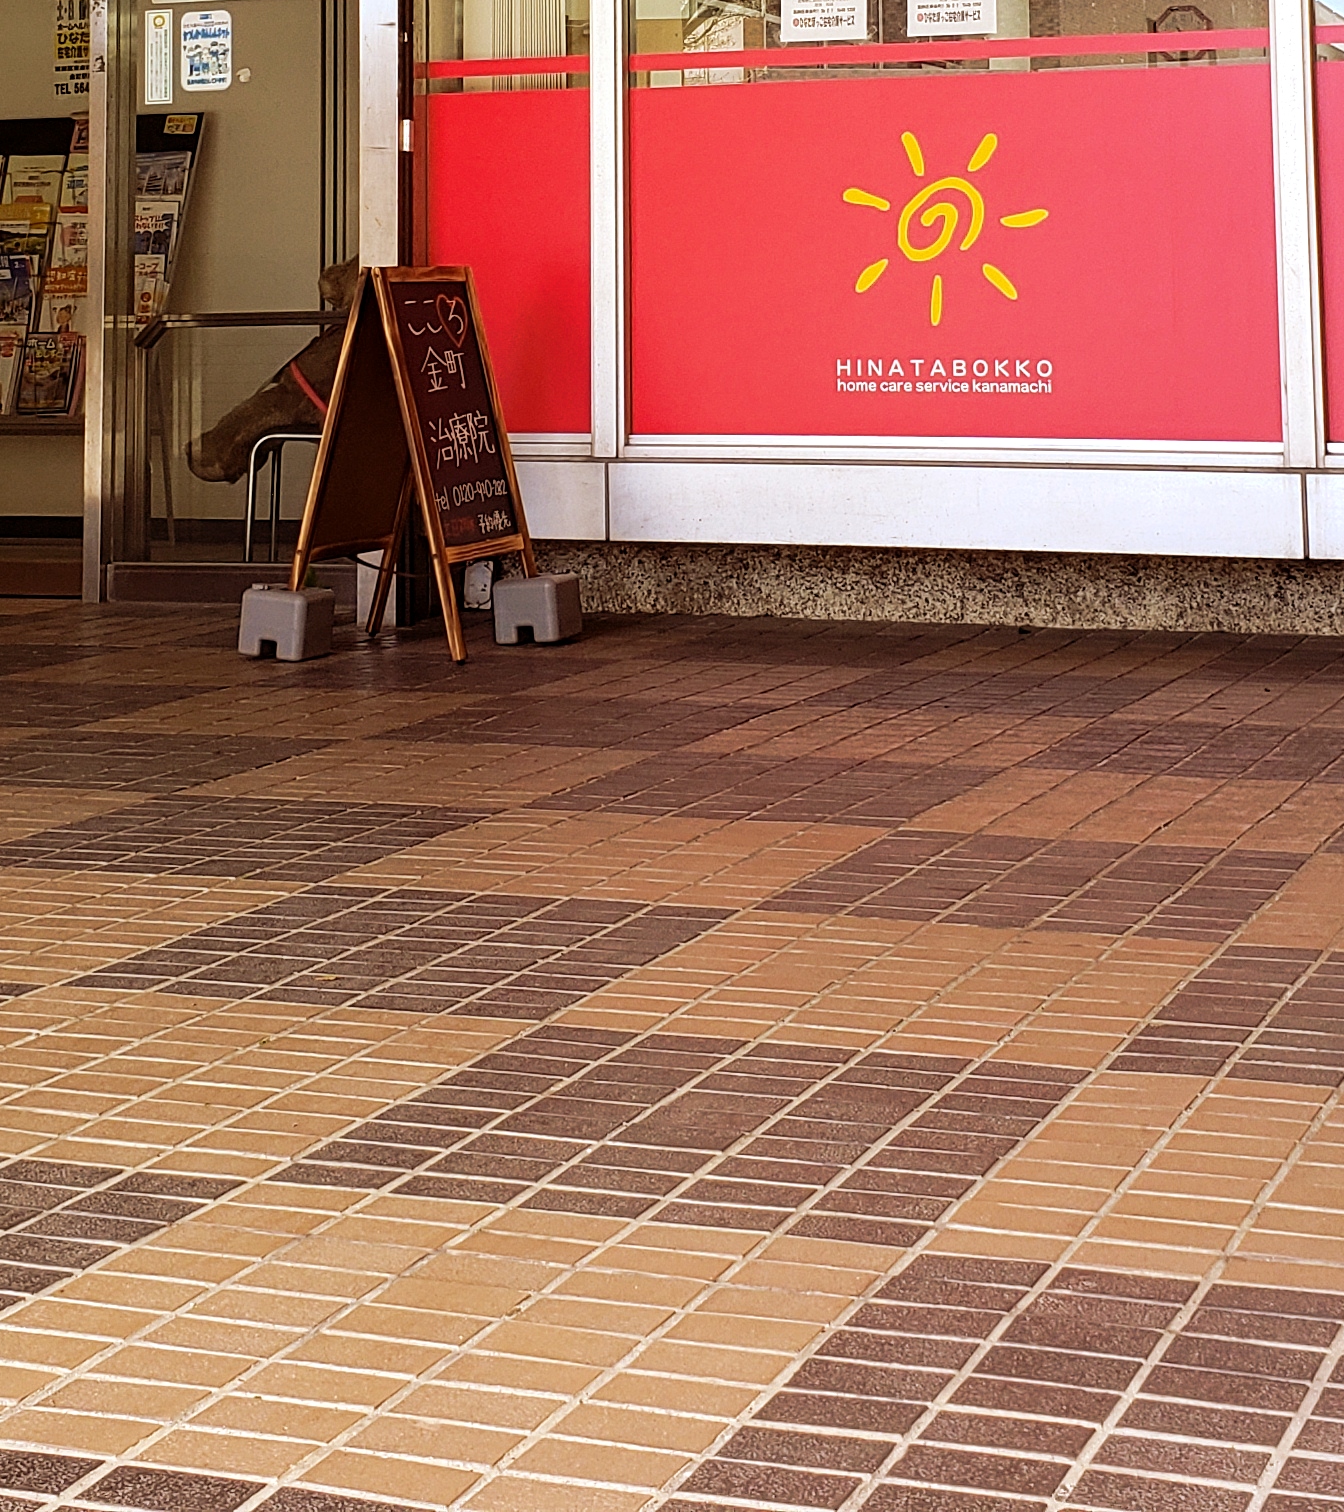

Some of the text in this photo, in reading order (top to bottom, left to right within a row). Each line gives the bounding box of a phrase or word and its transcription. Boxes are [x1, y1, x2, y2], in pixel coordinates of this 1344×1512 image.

[54, 83, 72, 95] TEL
[404, 298, 464, 336] こころ
[421, 345, 466, 393] 金町
[836, 359, 1053, 378] HINATABOKKO
[837, 379, 1053, 394] home care service kanamachi
[428, 409, 496, 470] 治療院
[435, 486, 450, 513] tel
